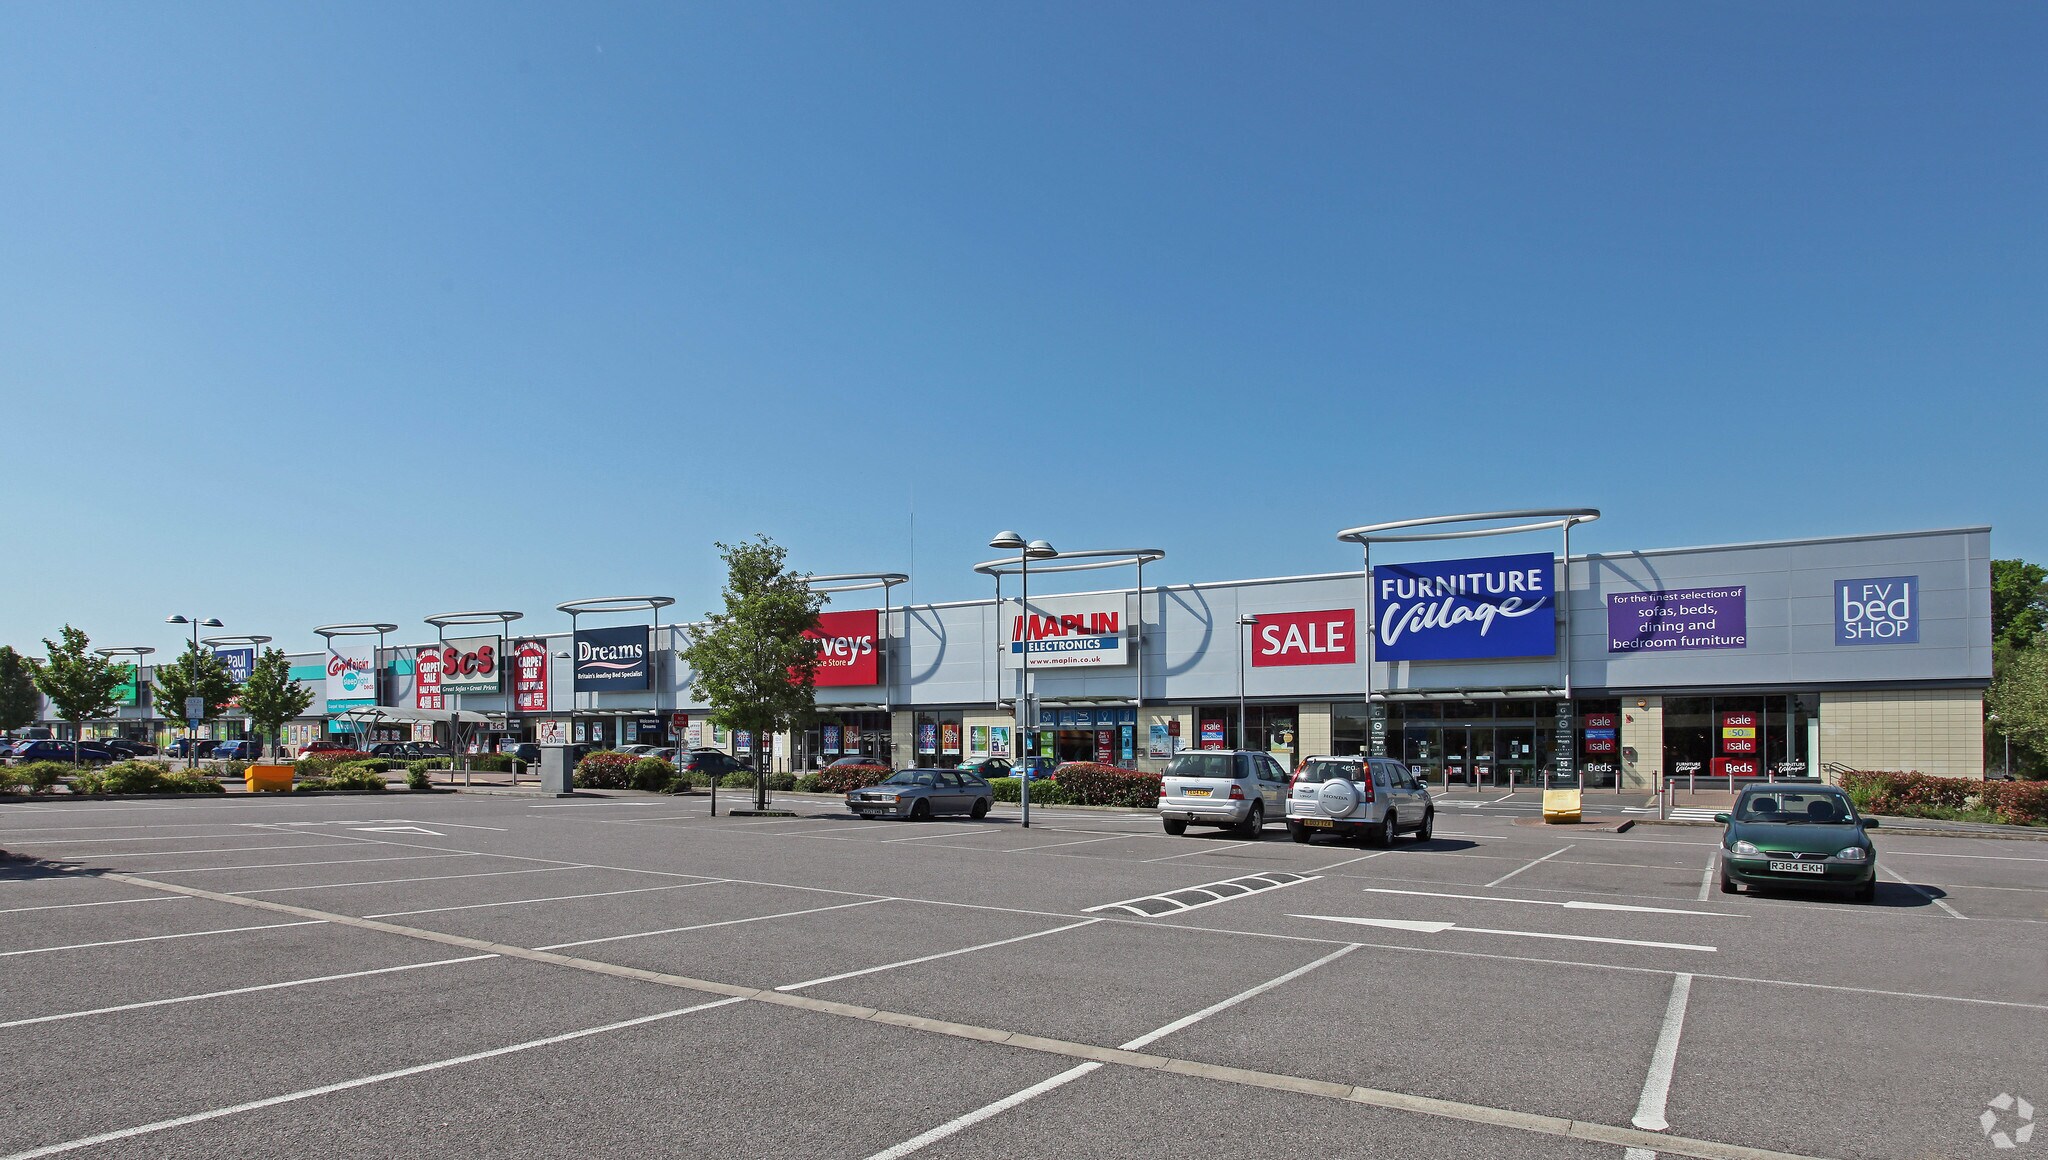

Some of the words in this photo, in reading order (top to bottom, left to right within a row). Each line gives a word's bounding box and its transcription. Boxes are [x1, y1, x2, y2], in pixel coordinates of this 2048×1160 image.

[1382, 569, 1543, 600] FURNITURE
[1613, 595, 1628, 604] for
[1630, 594, 1647, 603] the
[1649, 593, 1678, 602] finest
[1680, 590, 1728, 600] selection
[1730, 588, 1742, 597] of
[1863, 584, 1892, 601] FV
[1843, 582, 1910, 622] bed
[1638, 605, 1677, 617] sofas,
[1679, 603, 1718, 615] beds,
[1012, 611, 1118, 642] MAPLIN
[1380, 596, 1547, 647] Village
[1639, 621, 1684, 633] dining
[1688, 618, 1716, 630] and
[1845, 620, 1909, 639] SHOP
[1261, 621, 1345, 655] SALE
[1613, 637, 1677, 649] bedroom
[1681, 634, 1745, 646] furniture
[577, 641, 643, 662] Dreams
[804, 635, 872, 666] veys
[1028, 639, 1101, 652] ELECTRONICS
[228, 650, 246, 668] Paul
[442, 645, 494, 675] ScS
[518, 655, 543, 668] CARPET
[828, 659, 847, 667] Store
[1029, 656, 1101, 665] www.maplin.co.uk
[420, 662, 440, 673] CARPET
[522, 667, 538, 679] SALE
[423, 672, 437, 683] SALE
[595, 671, 612, 680] leading
[612, 671, 621, 679] Bed
[621, 670, 643, 679] Specialist
[419, 685, 430, 694] HALF
[455, 685, 467, 693] Sofas
[517, 681, 530, 691] HALF
[530, 681, 544, 690] PRICE
[1591, 716, 1611, 726] sale
[1730, 715, 1751, 725] sale
[1207, 722, 1220, 731] sale
[1591, 740, 1611, 751] sale
[1730, 740, 1751, 750] sale
[1587, 762, 1612, 772] Beds
[1725, 763, 1753, 773] Beds
[1771, 862, 1799, 871] R384
[1801, 864, 1823, 872] EKH
